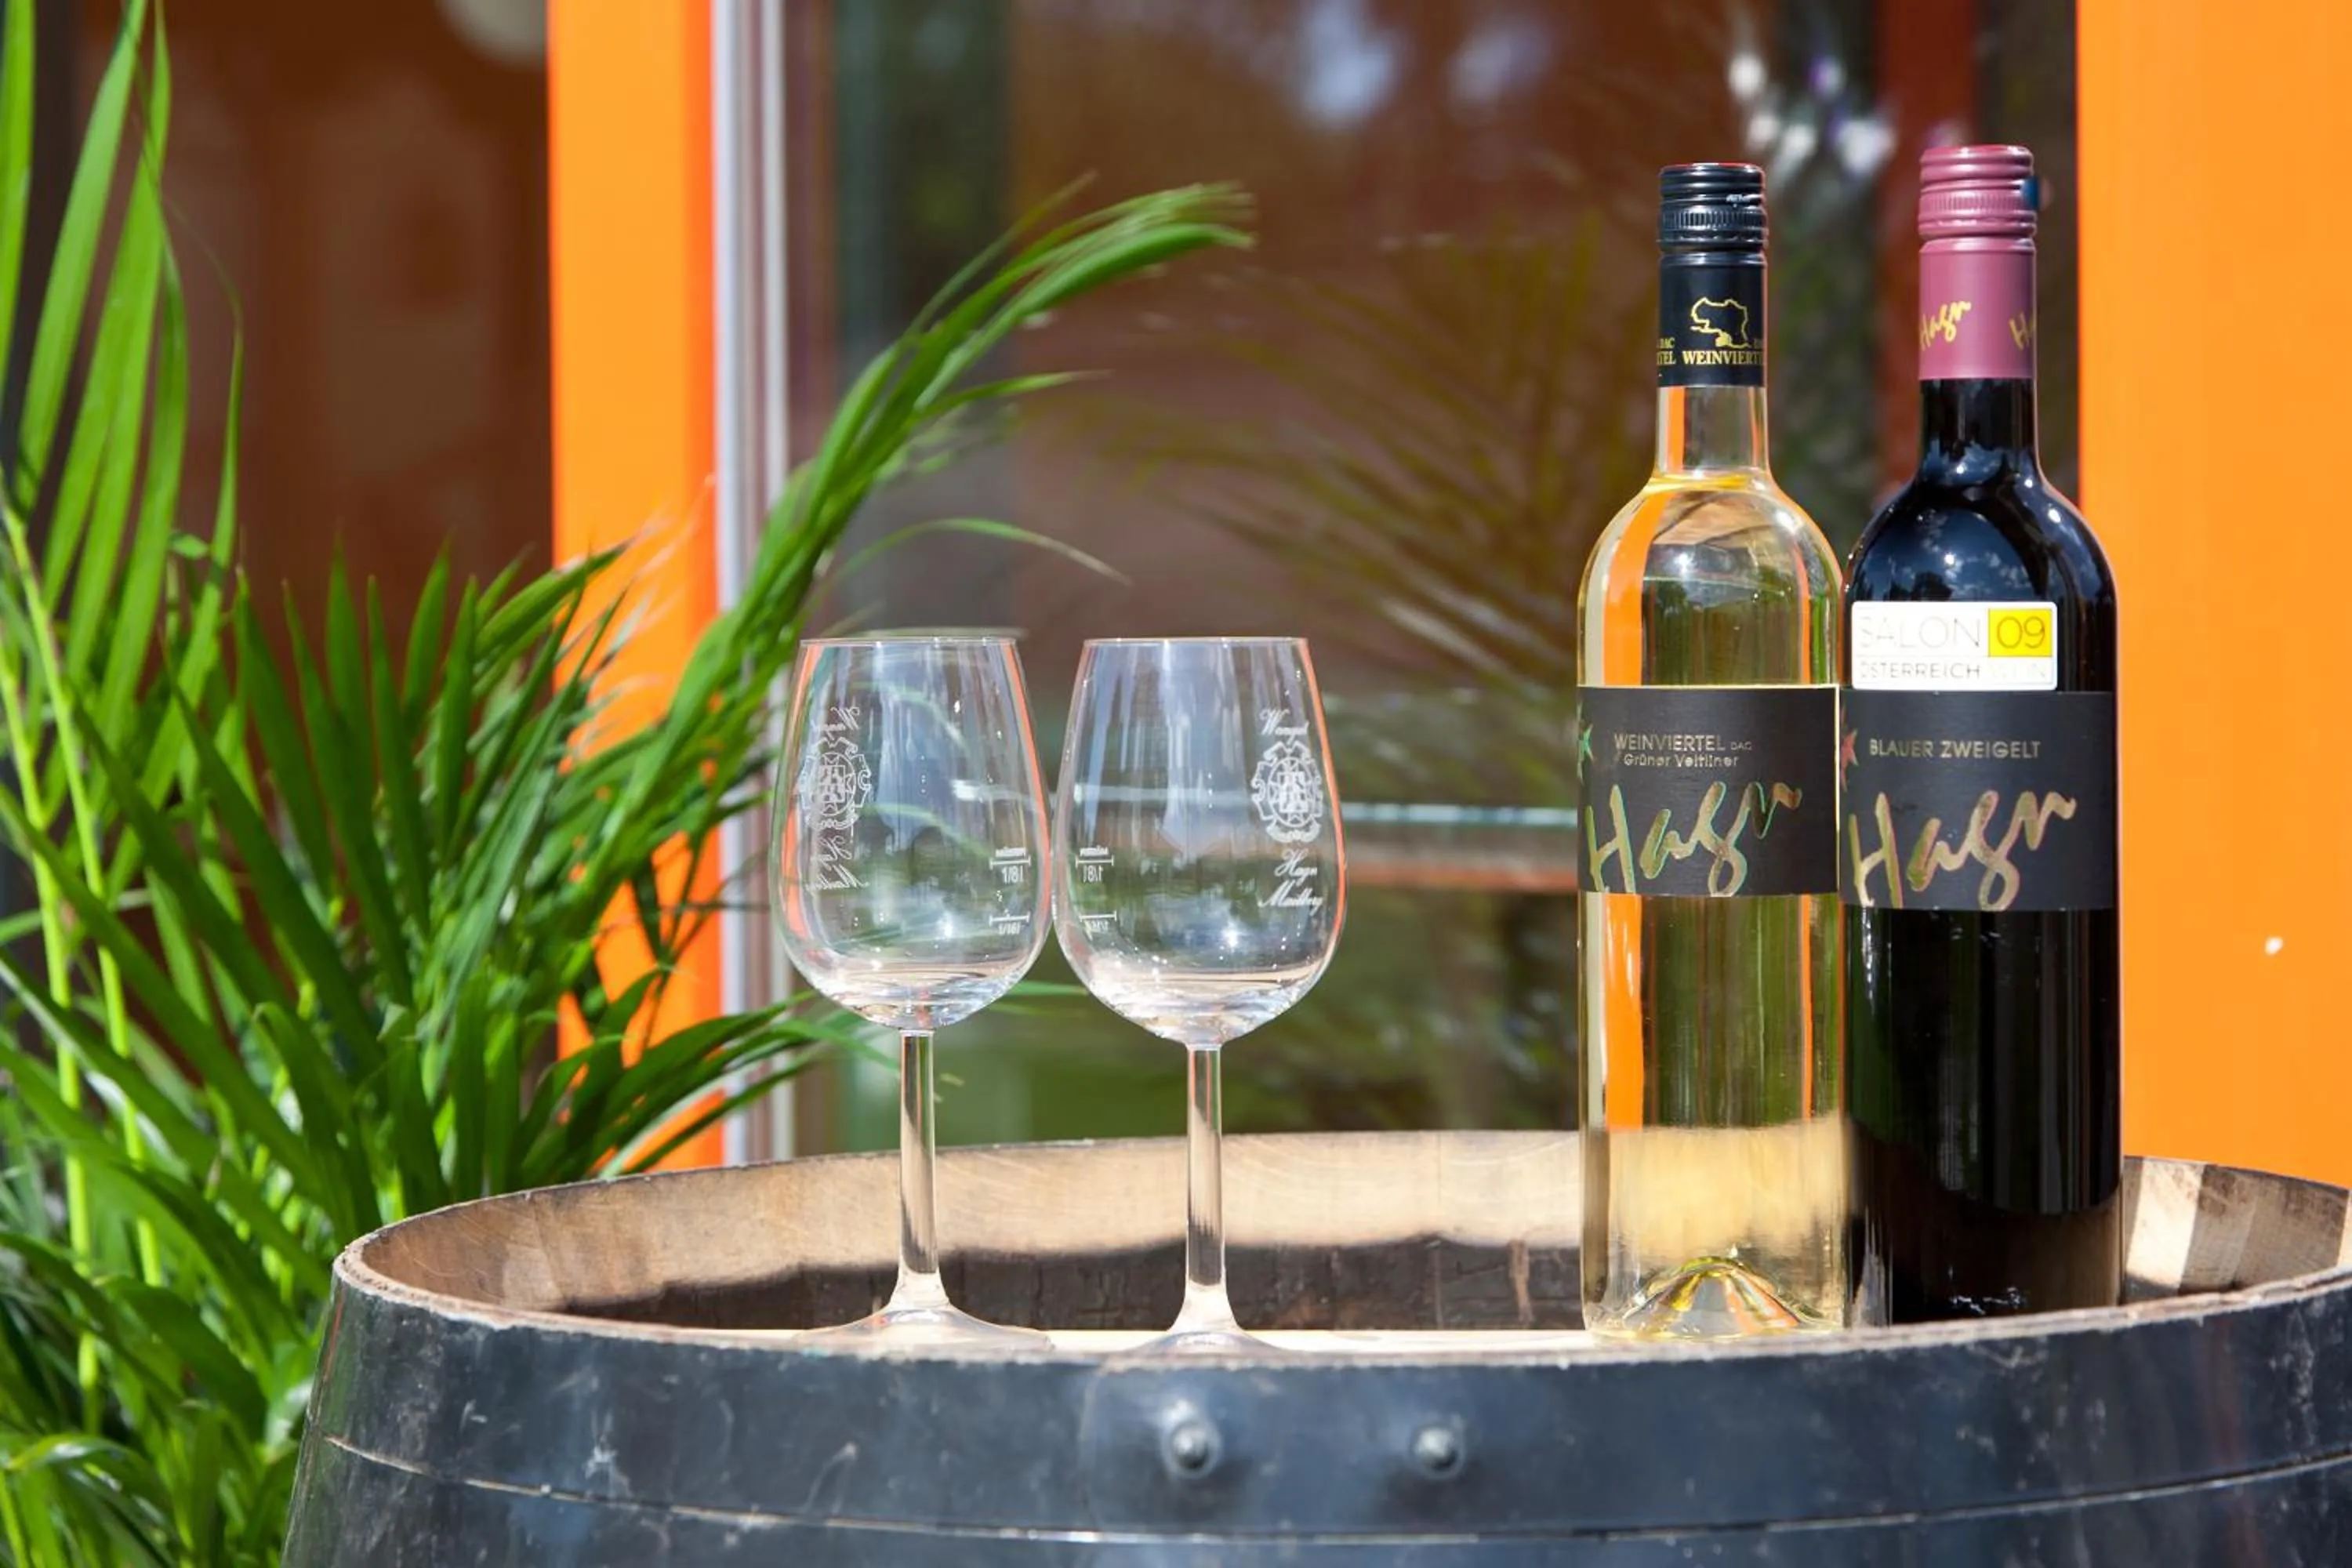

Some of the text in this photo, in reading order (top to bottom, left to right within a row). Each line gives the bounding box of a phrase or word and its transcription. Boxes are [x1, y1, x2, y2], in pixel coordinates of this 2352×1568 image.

[1860, 615, 2045, 649] SALON 09
[1613, 733, 1726, 752] WEINVIERTEL
[1869, 738, 2041, 759] BLAUER ZWEIGELT
